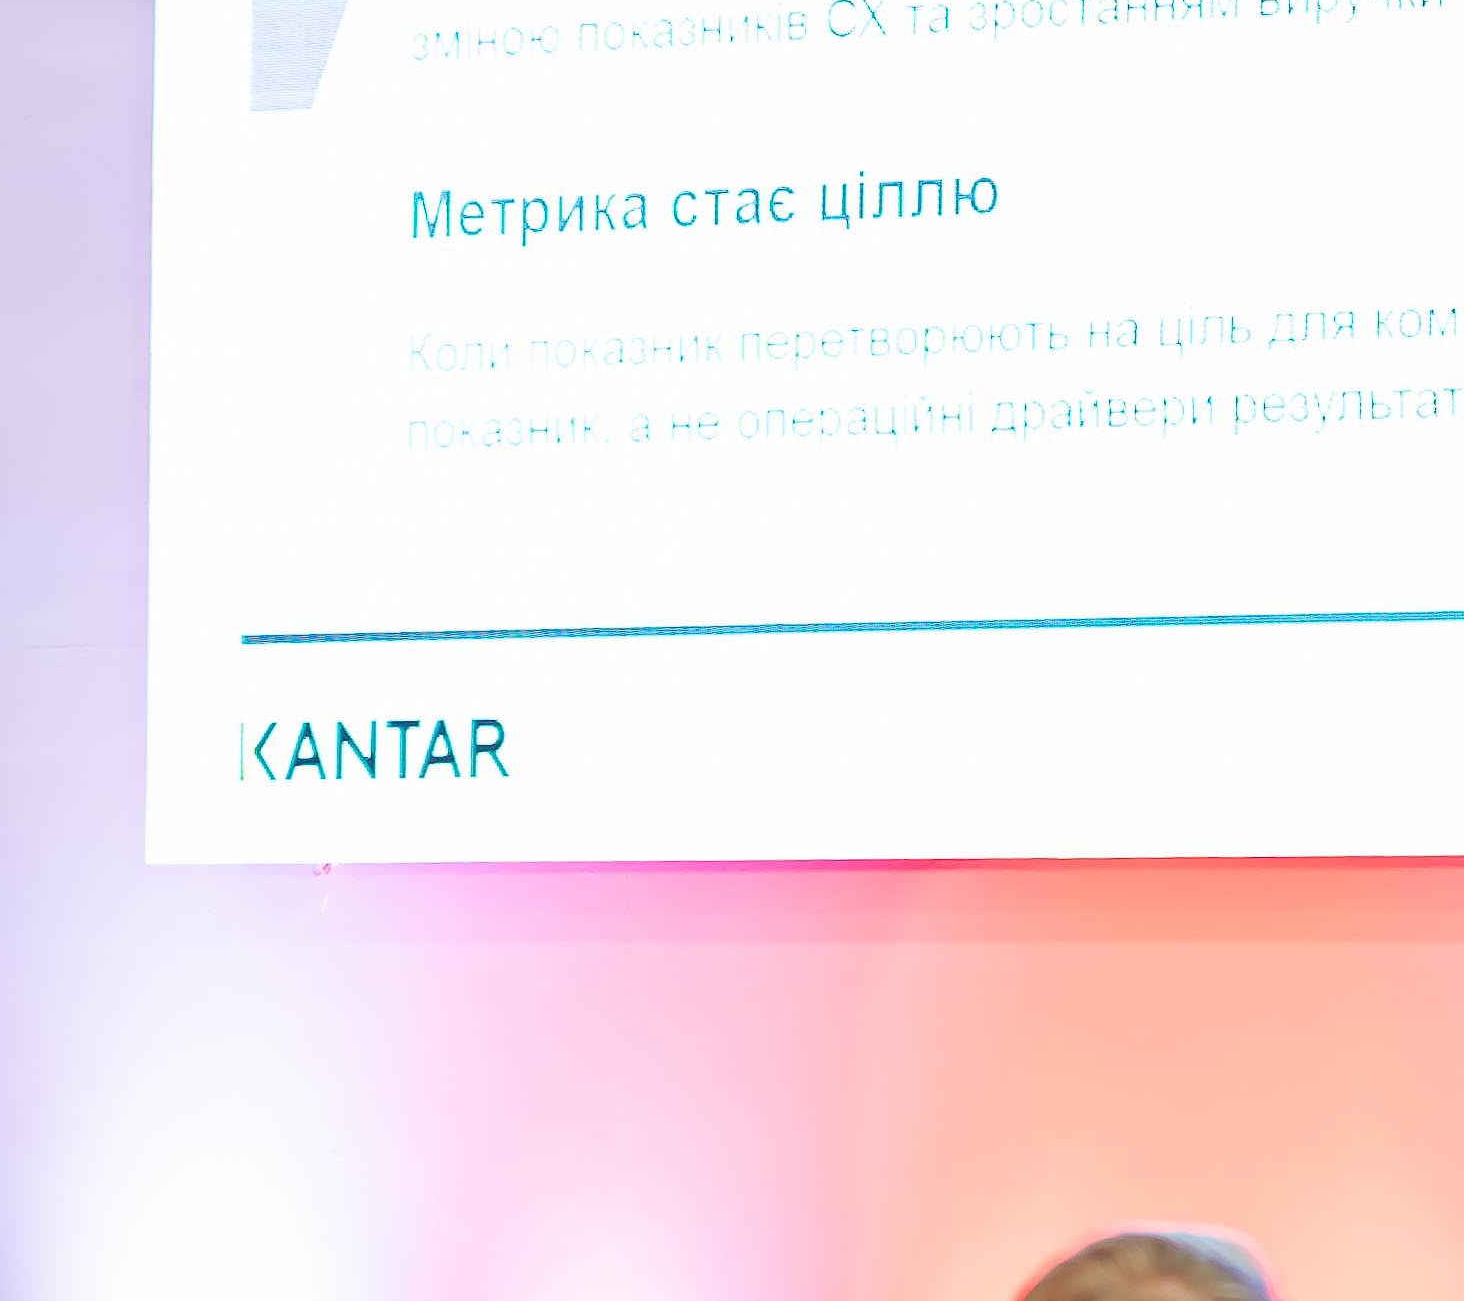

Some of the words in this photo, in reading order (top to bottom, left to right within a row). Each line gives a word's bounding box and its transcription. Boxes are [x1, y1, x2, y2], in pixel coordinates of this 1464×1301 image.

[412, 19, 560, 65] зміною
[577, 1, 809, 57] показників
[903, 2, 951, 38] та
[410, 187, 648, 248] Метрика
[670, 177, 796, 229] стає
[819, 169, 999, 231] ціллю
[407, 330, 511, 374] Коли
[528, 327, 724, 371] показник
[738, 319, 1070, 371] перетворюють
[1087, 313, 1141, 351] на
[1158, 300, 1252, 357] ціль
[1266, 307, 1357, 353] для
[629, 411, 651, 444] а
[669, 410, 721, 444] не
[737, 390, 975, 448] операційні
[989, 388, 1215, 446] драйвери
[238, 716, 510, 783] KANTAR
